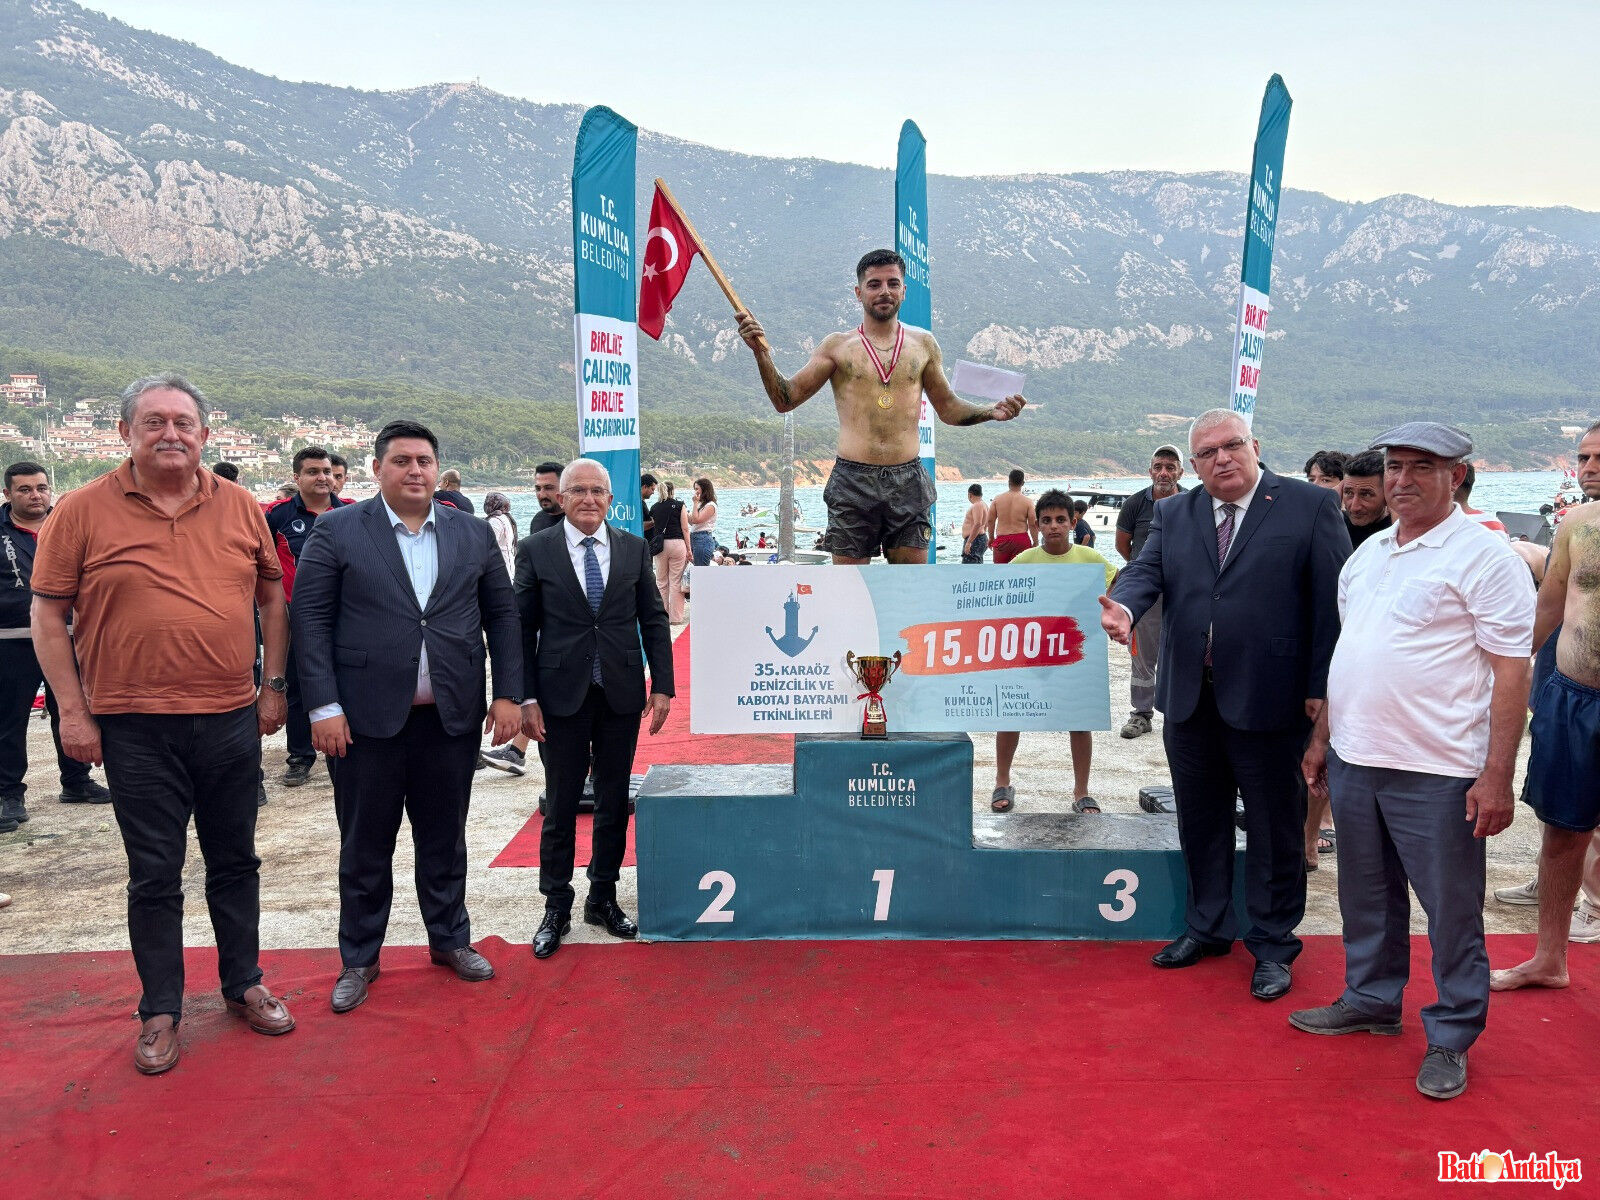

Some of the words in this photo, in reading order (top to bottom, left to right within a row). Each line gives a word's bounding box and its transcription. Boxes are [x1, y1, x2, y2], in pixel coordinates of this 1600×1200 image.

[600, 193, 618, 222] T.C.
[1253, 180, 1276, 223] KUMLU
[580, 211, 630, 257] KUMLUCA
[951, 581, 977, 595] YAĞLI
[978, 579, 1005, 592] DİREK
[1007, 576, 1037, 590] YARIŞI
[956, 594, 1003, 610] BİRİNCİLİK
[1005, 591, 1035, 606] ÖDÜLÜ
[923, 621, 1042, 668] 15.000
[1046, 632, 1070, 657] TL
[781, 663, 831, 676] KARAÖZ
[750, 678, 817, 692] DENİZCİLİK
[819, 680, 835, 691] VE
[960, 685, 976, 695] T.C.
[737, 695, 790, 706] KABOTAJ
[793, 694, 848, 705] BAYRAMI
[944, 696, 993, 707] KUMLUCA
[1001, 691, 1030, 700] Mesut
[945, 707, 993, 717] BELEDİYESİ
[1002, 700, 1053, 710] AVCIOĞLU
[753, 707, 833, 721] ETKİNLİKLERİ
[871, 763, 893, 776] T.C.
[848, 778, 916, 792] KUMLUCA
[848, 792, 916, 807] BELEDİYESİ
[695, 869, 737, 923] 2
[871, 869, 895, 921] 1
[1098, 869, 1140, 922] 3
